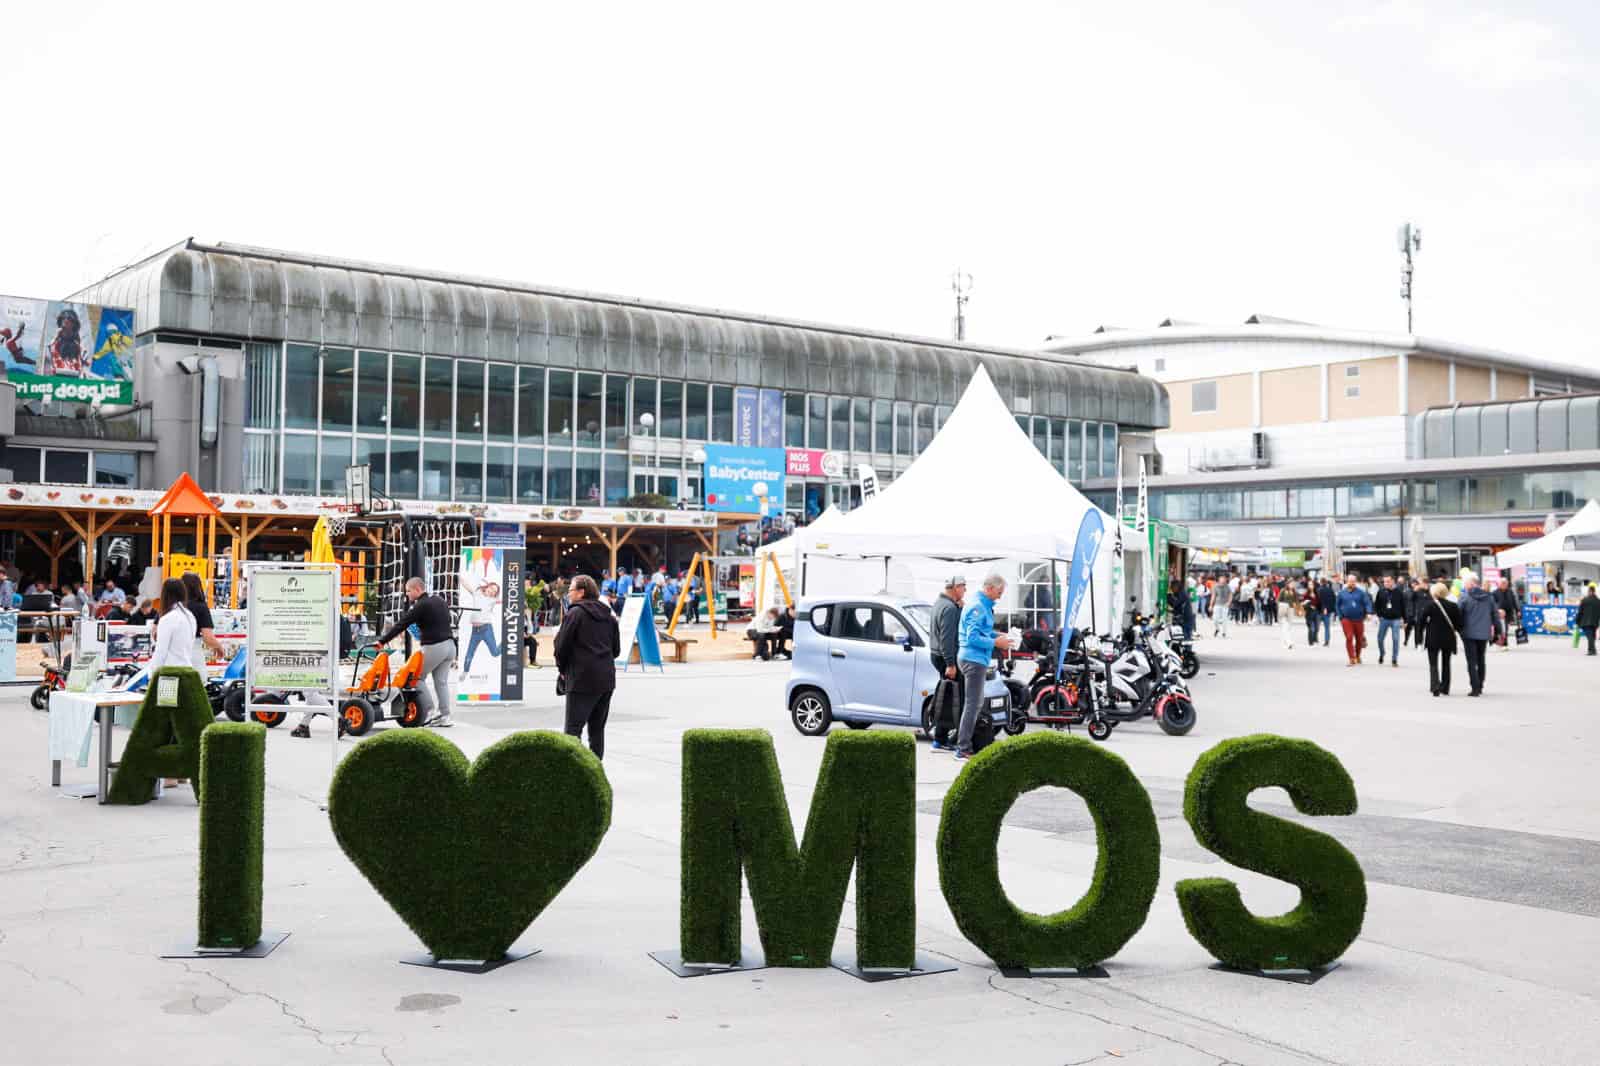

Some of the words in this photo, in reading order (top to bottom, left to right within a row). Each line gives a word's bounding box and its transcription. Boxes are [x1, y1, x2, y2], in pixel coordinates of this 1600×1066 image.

[789, 452, 808, 462] MOS
[708, 465, 781, 482] BabyCenter
[789, 463, 810, 473] PLUS
[262, 656, 323, 667] GREENART
[110, 666, 216, 806] A
[198, 722, 267, 952] I
[680, 728, 1368, 972] MOS
